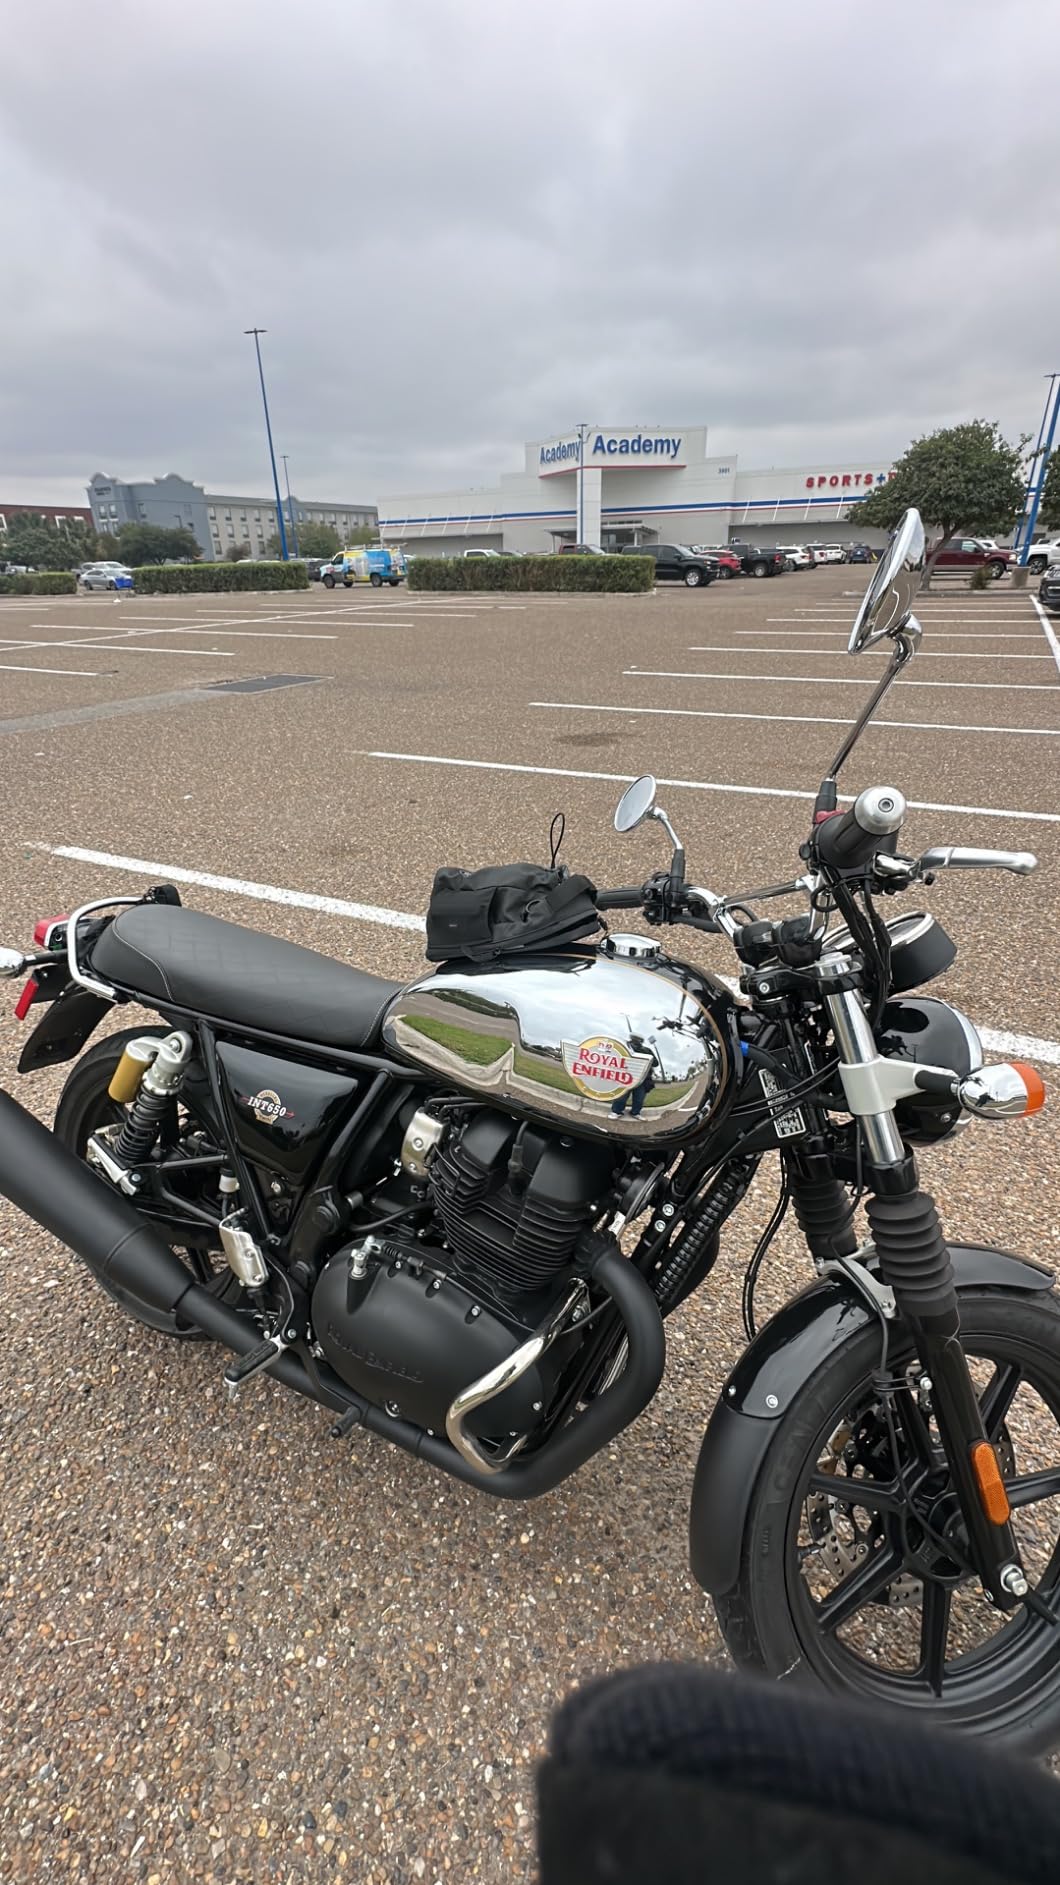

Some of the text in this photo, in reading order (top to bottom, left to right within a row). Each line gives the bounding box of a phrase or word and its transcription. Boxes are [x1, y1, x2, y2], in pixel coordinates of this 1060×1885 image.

[539, 440, 582, 464] Academy
[593, 434, 681, 458] Academy
[806, 473, 873, 488] SPORTS
[580, 1048, 628, 1069] ROYAL
[573, 1062, 633, 1084] ENFIELD
[248, 1096, 286, 1116] INT650
